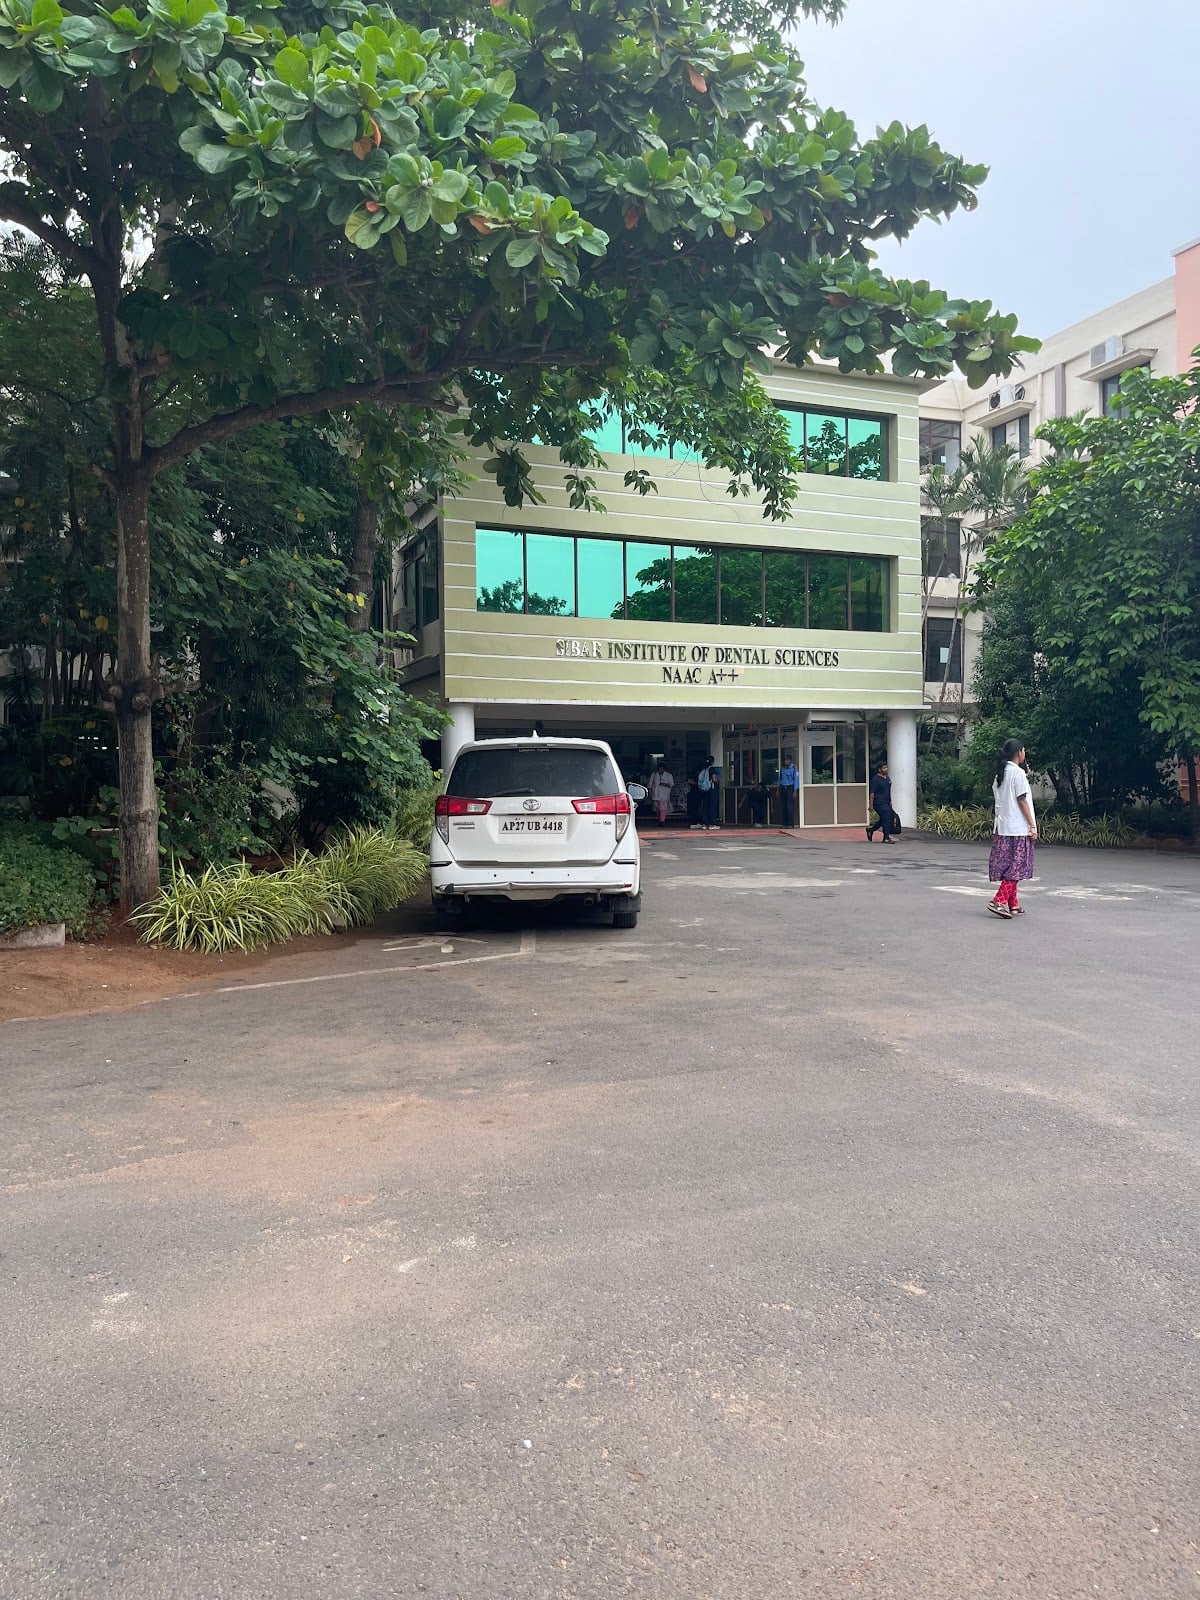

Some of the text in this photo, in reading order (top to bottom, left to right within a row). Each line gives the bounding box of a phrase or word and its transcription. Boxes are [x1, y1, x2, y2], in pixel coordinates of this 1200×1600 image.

[556, 639, 839, 667] SIBAR INSTITUTE OF DENTAL SCIENCES
[662, 667, 739, 685] NAAC A++
[502, 821, 563, 831] AP27 UB 4418
